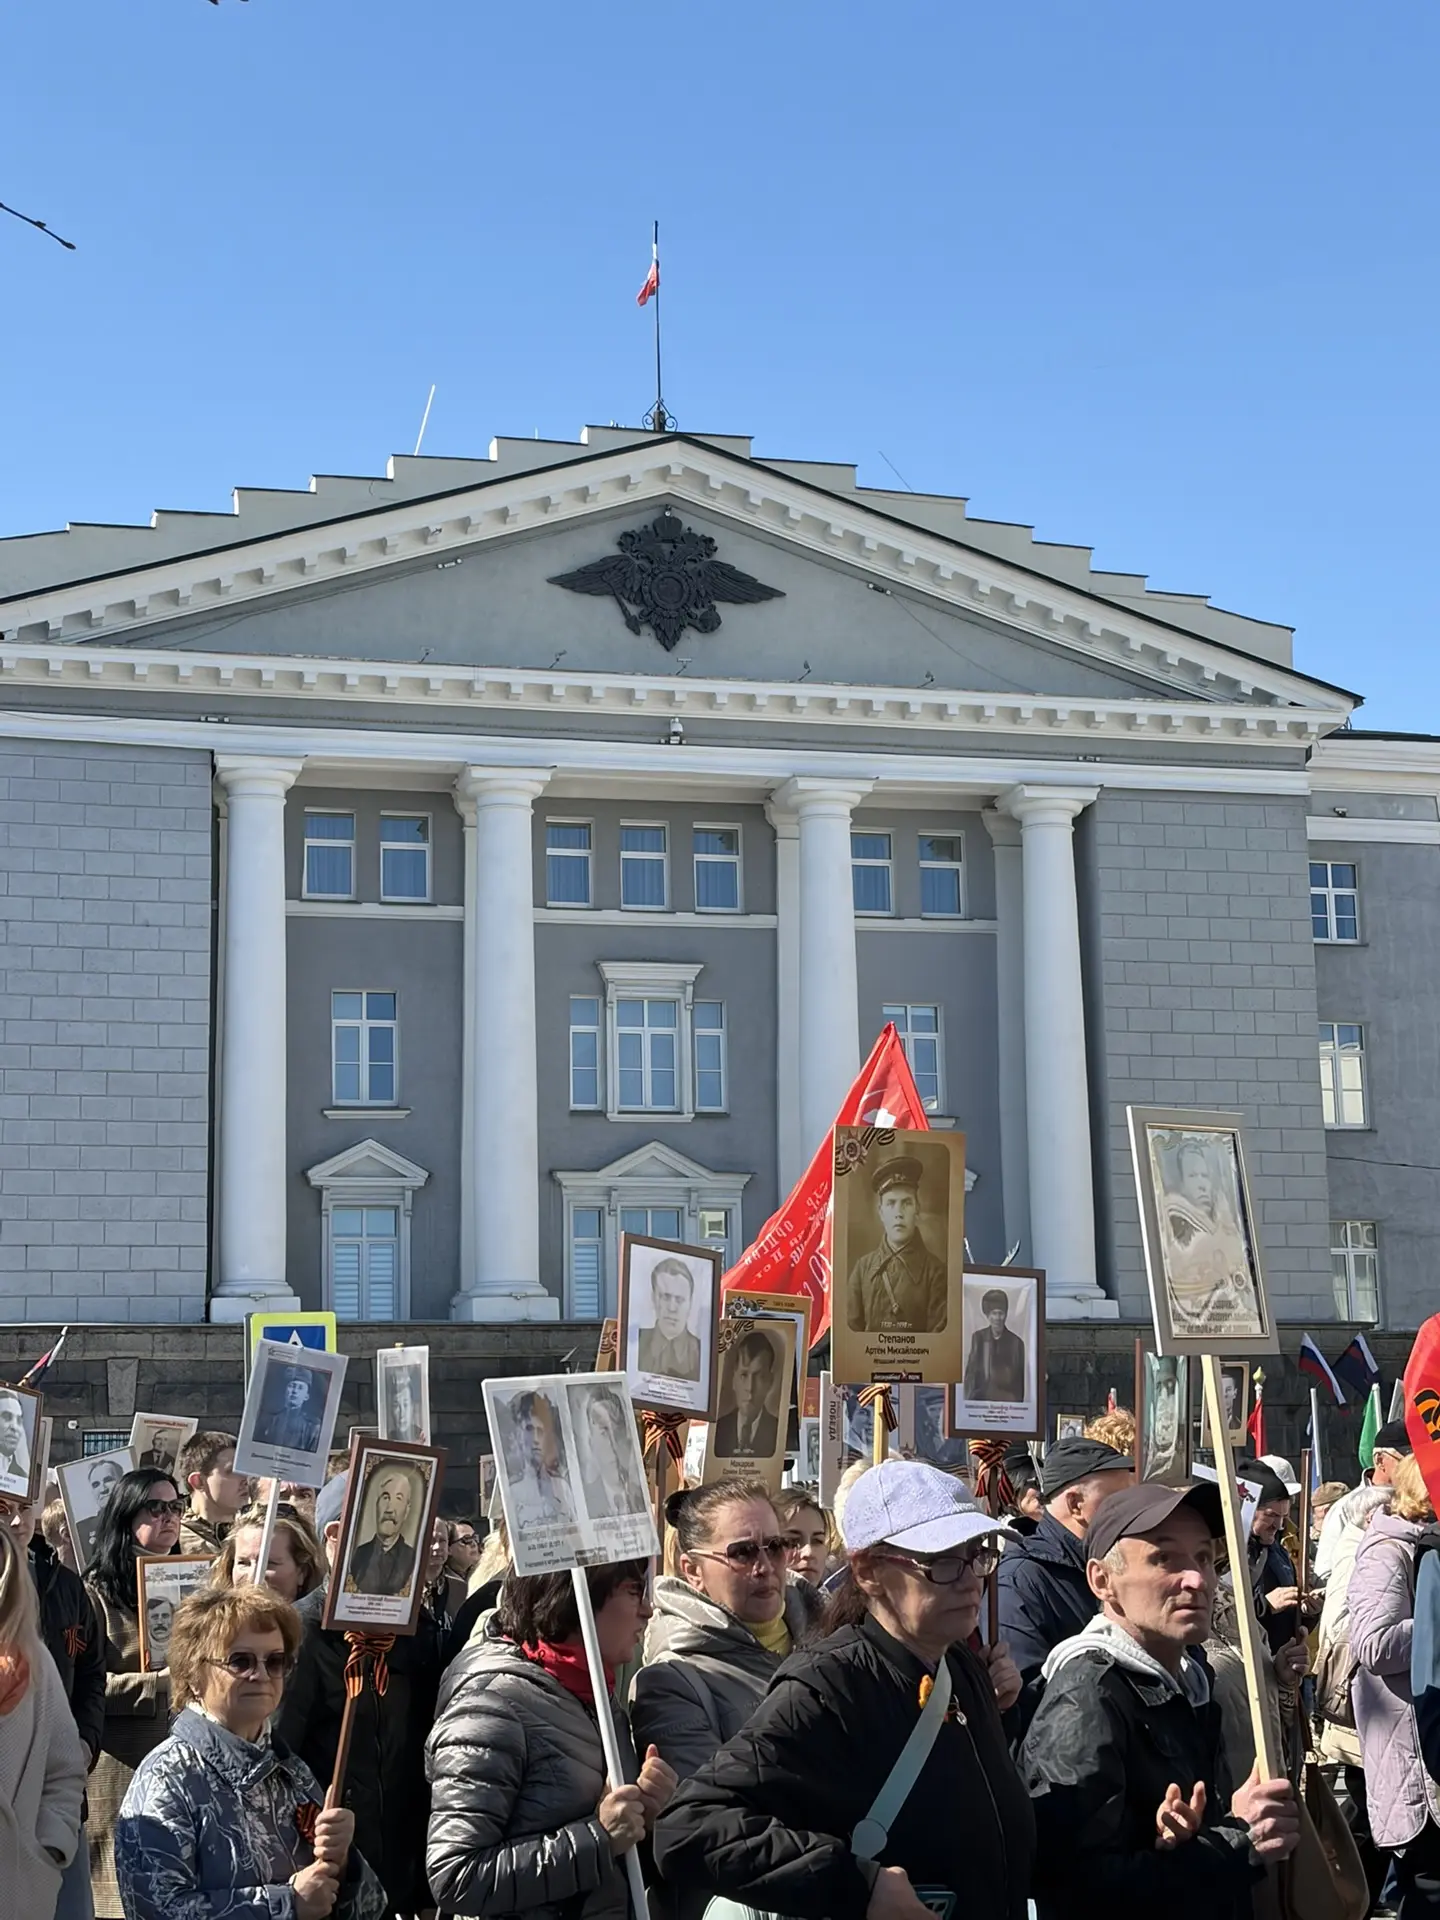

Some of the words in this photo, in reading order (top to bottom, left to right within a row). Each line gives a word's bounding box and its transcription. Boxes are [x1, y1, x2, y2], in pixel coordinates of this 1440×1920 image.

[878, 1333, 916, 1344] Степанов
[887, 1345, 930, 1355] Михайлович
[829, 1401, 837, 1441] ПОБЕДА
